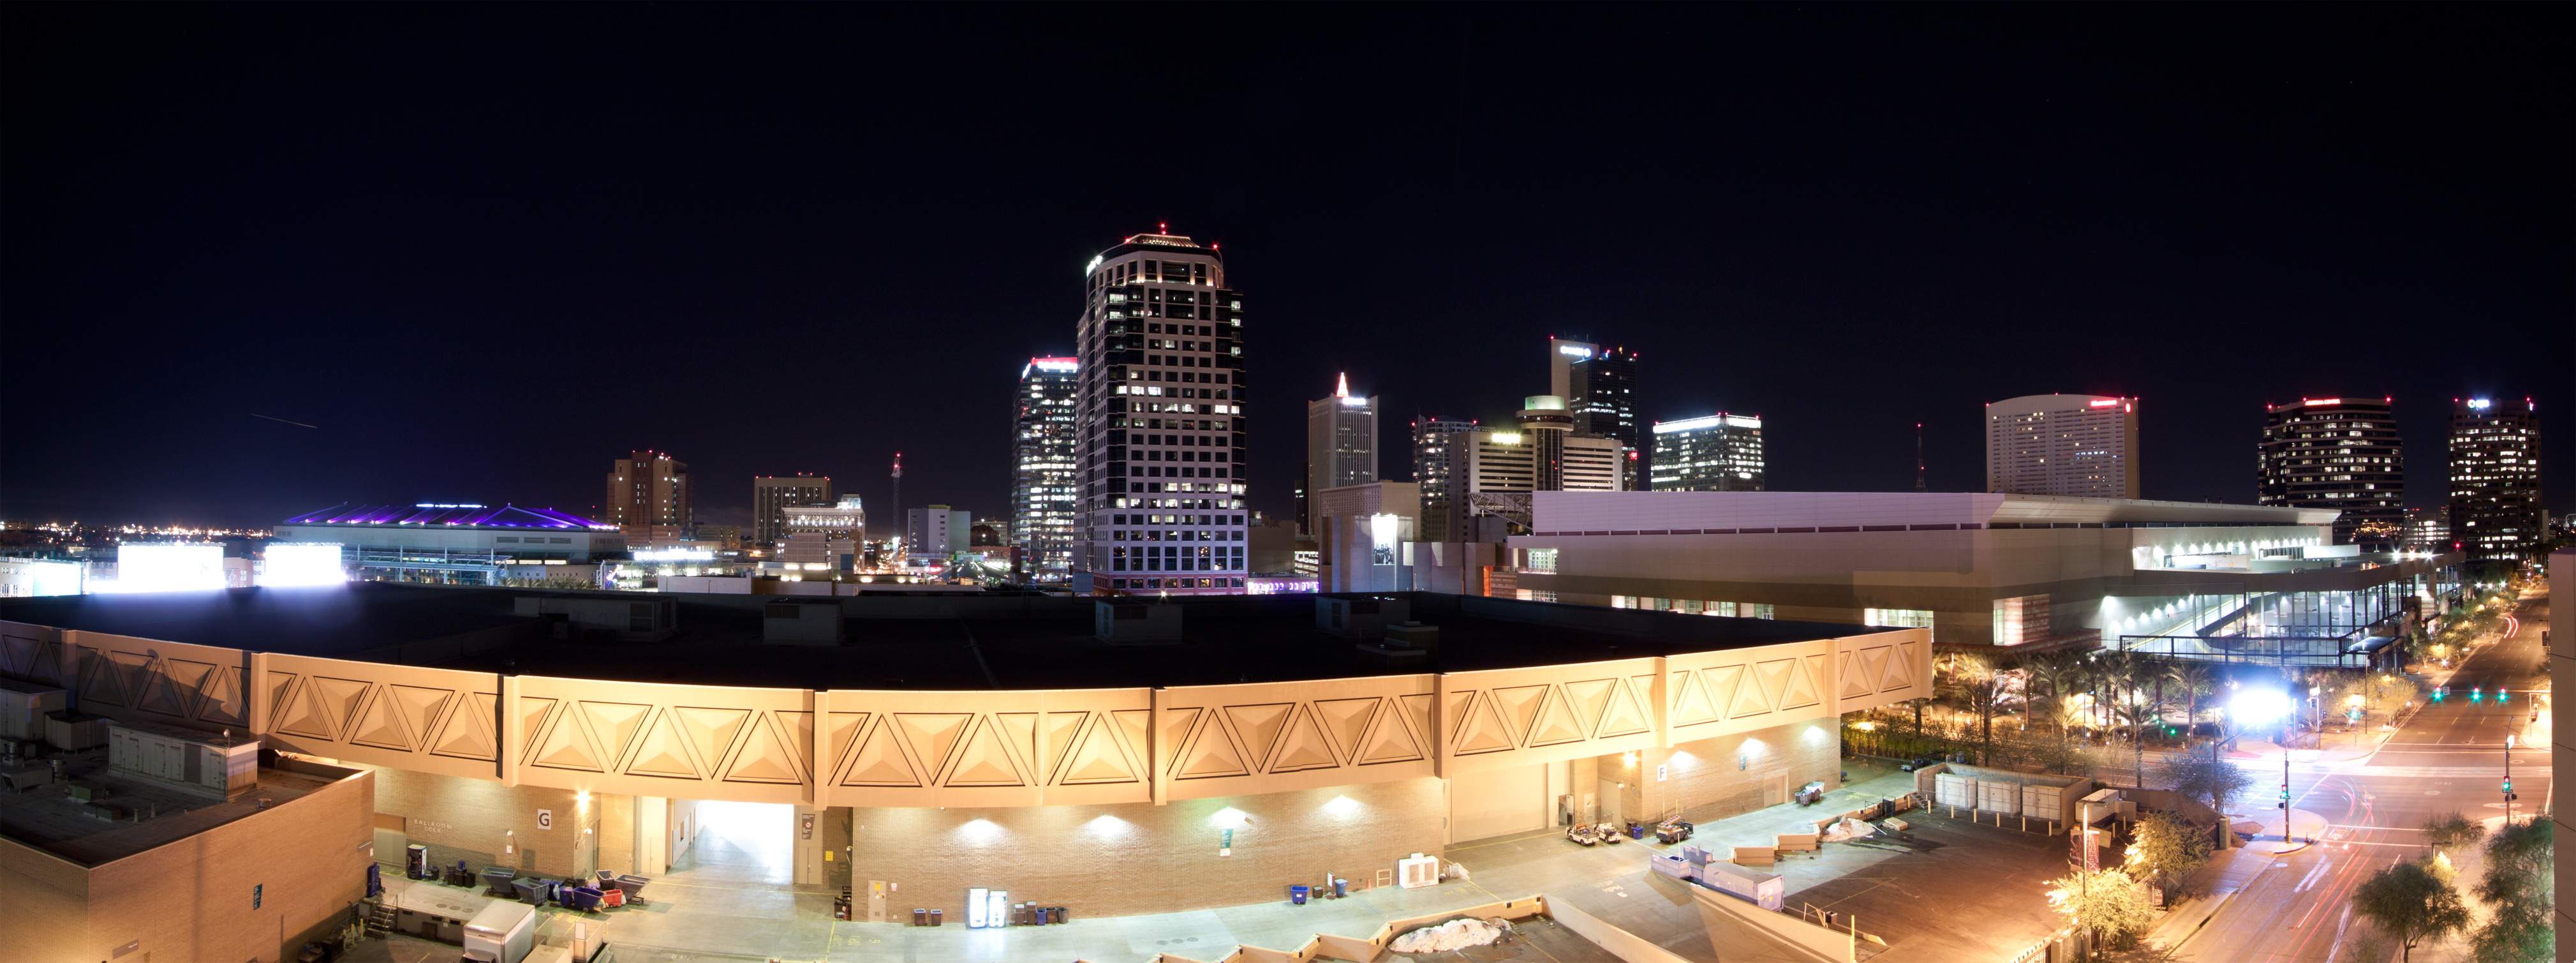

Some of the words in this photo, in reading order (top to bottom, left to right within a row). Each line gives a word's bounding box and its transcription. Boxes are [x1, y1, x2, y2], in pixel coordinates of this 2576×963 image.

[1660, 767, 1664, 779] F
[415, 819, 452, 830] BALLROOM
[539, 812, 549, 826] G
[2091, 832, 2099, 863] owntown
